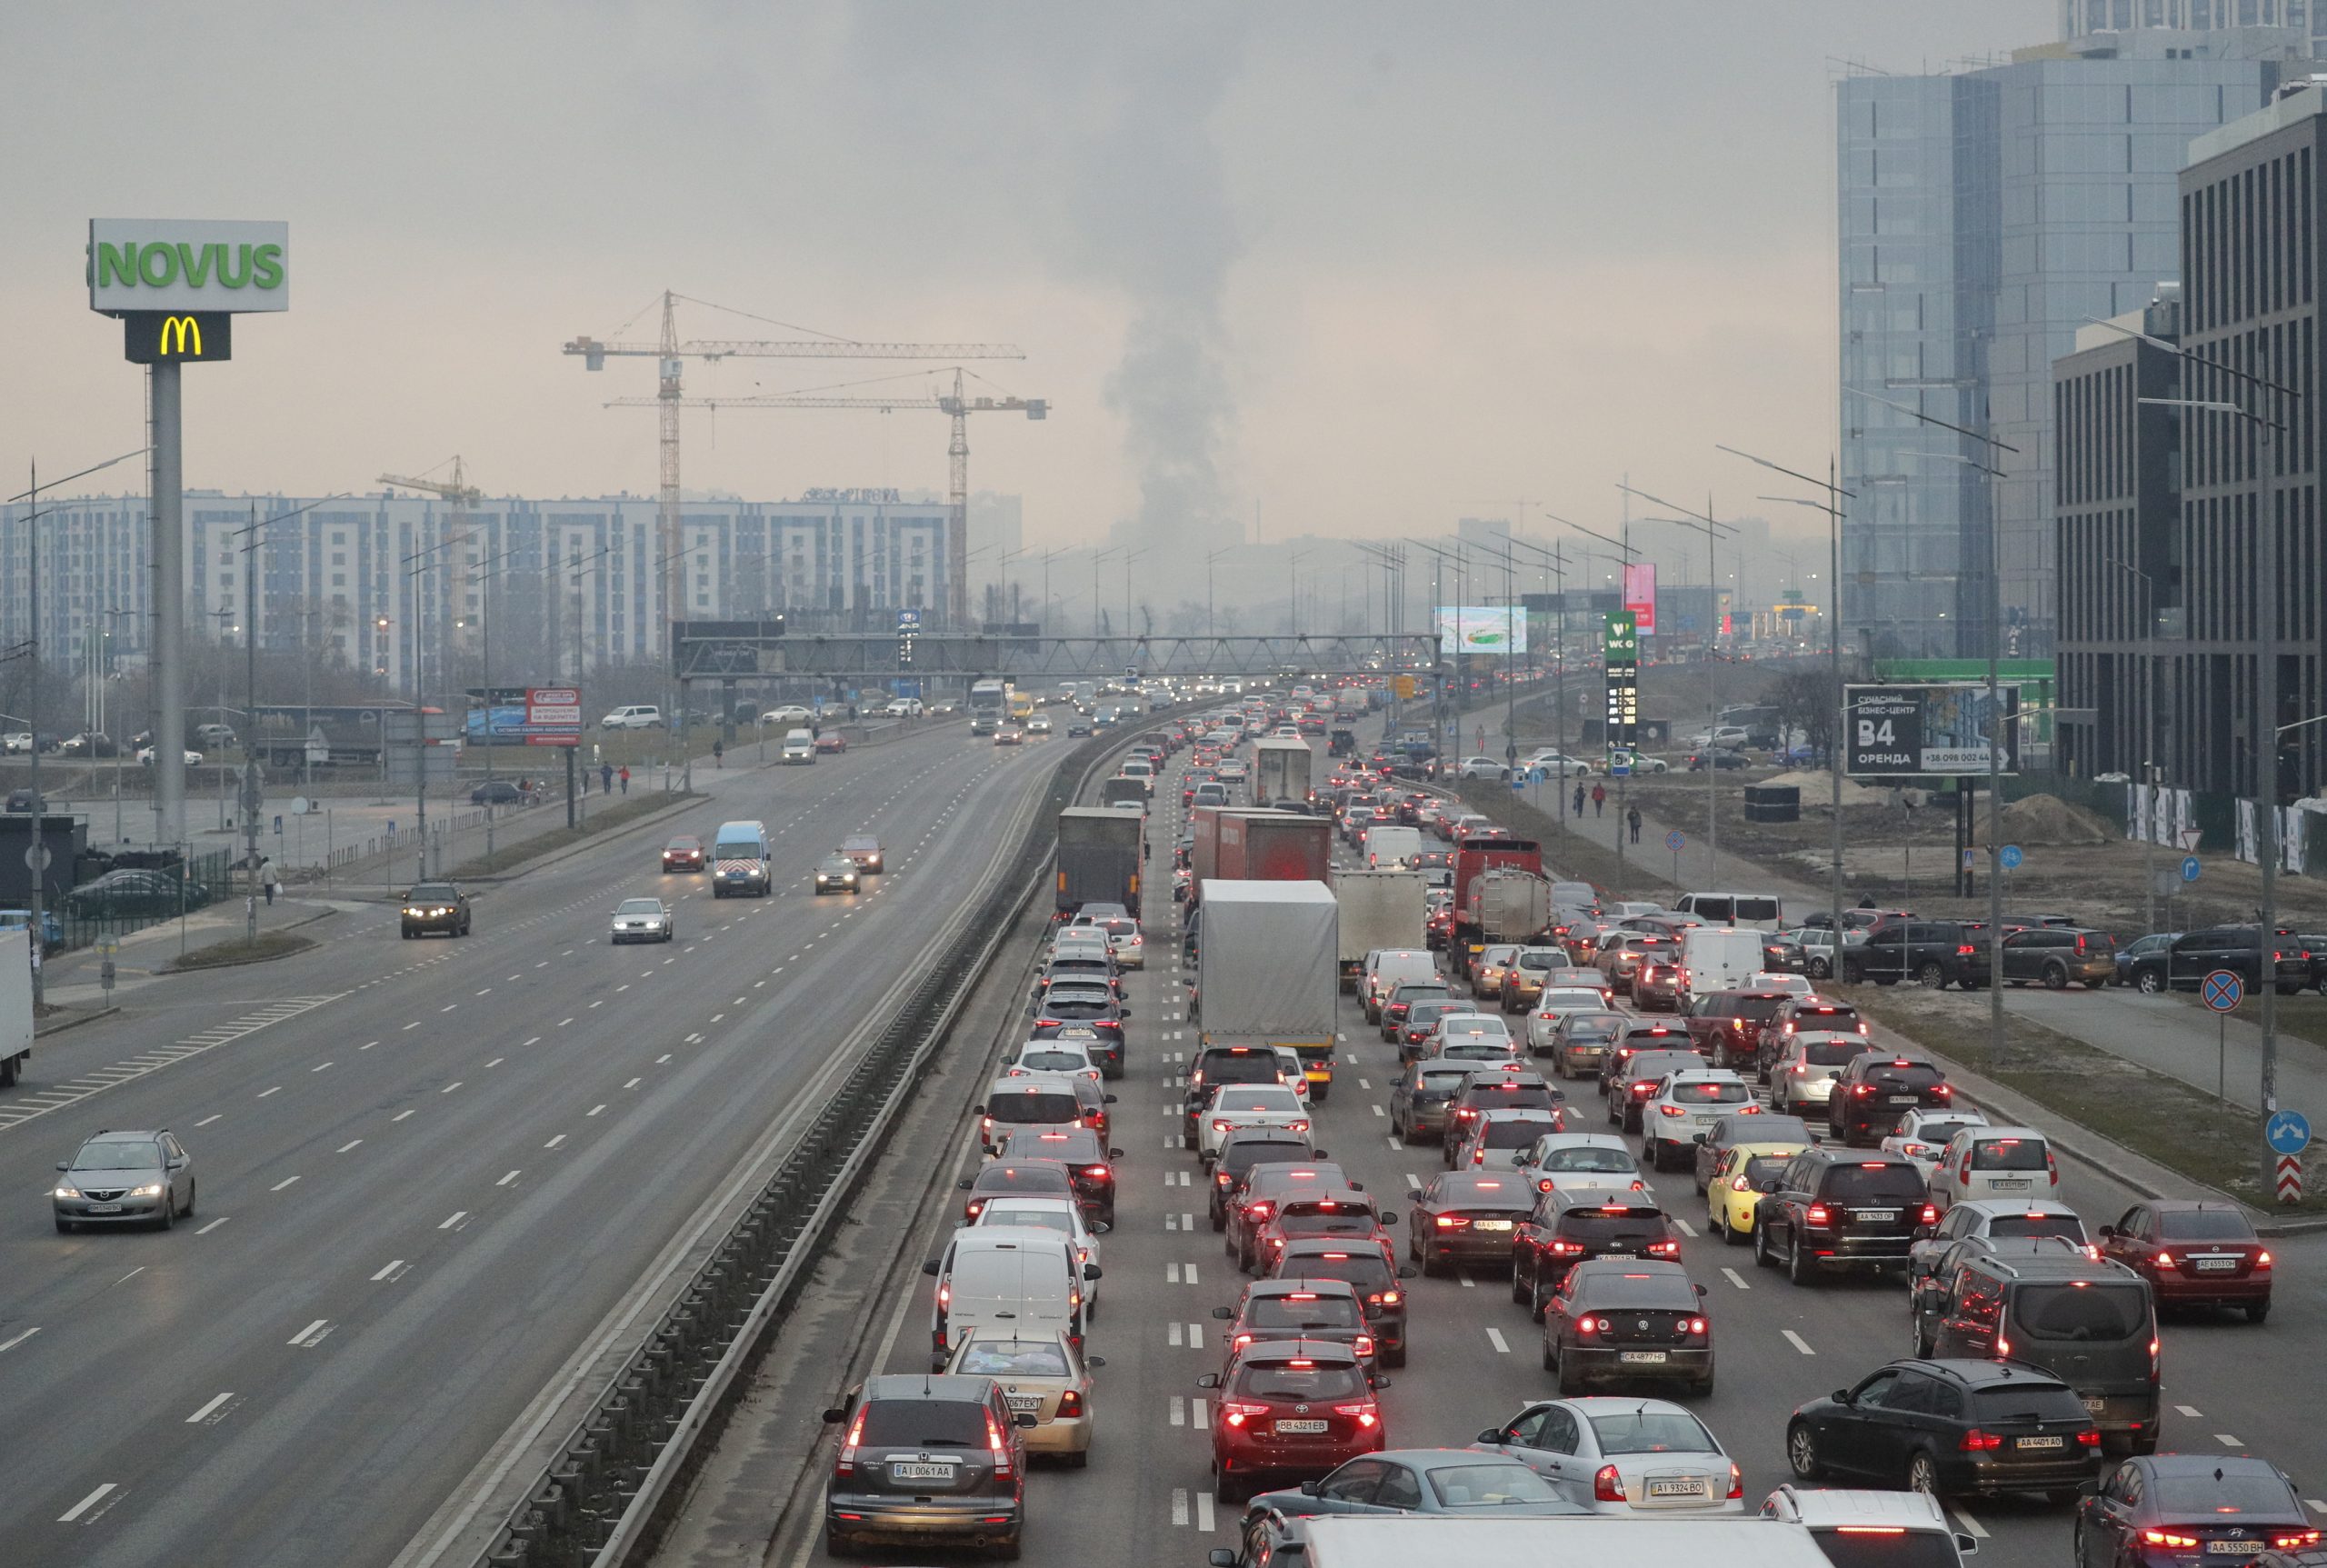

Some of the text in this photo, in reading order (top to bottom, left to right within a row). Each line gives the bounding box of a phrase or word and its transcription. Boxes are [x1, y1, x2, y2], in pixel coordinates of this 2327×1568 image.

[98, 242, 284, 289] NOVUS
[1858, 694, 1903, 704] СУЧАСНИЙ
[1858, 754, 1911, 764] ОРЕНДА
[1024, 1399, 1035, 1408] EK
[1280, 1421, 1325, 1430] BB 4321 EB
[2021, 1437, 2061, 1447] AA 4401 AO
[901, 1466, 949, 1475] AI 0061 AA
[1657, 1483, 1702, 1493] AI 9324 BO
[2212, 1543, 2263, 1553] AA 5550 BH
